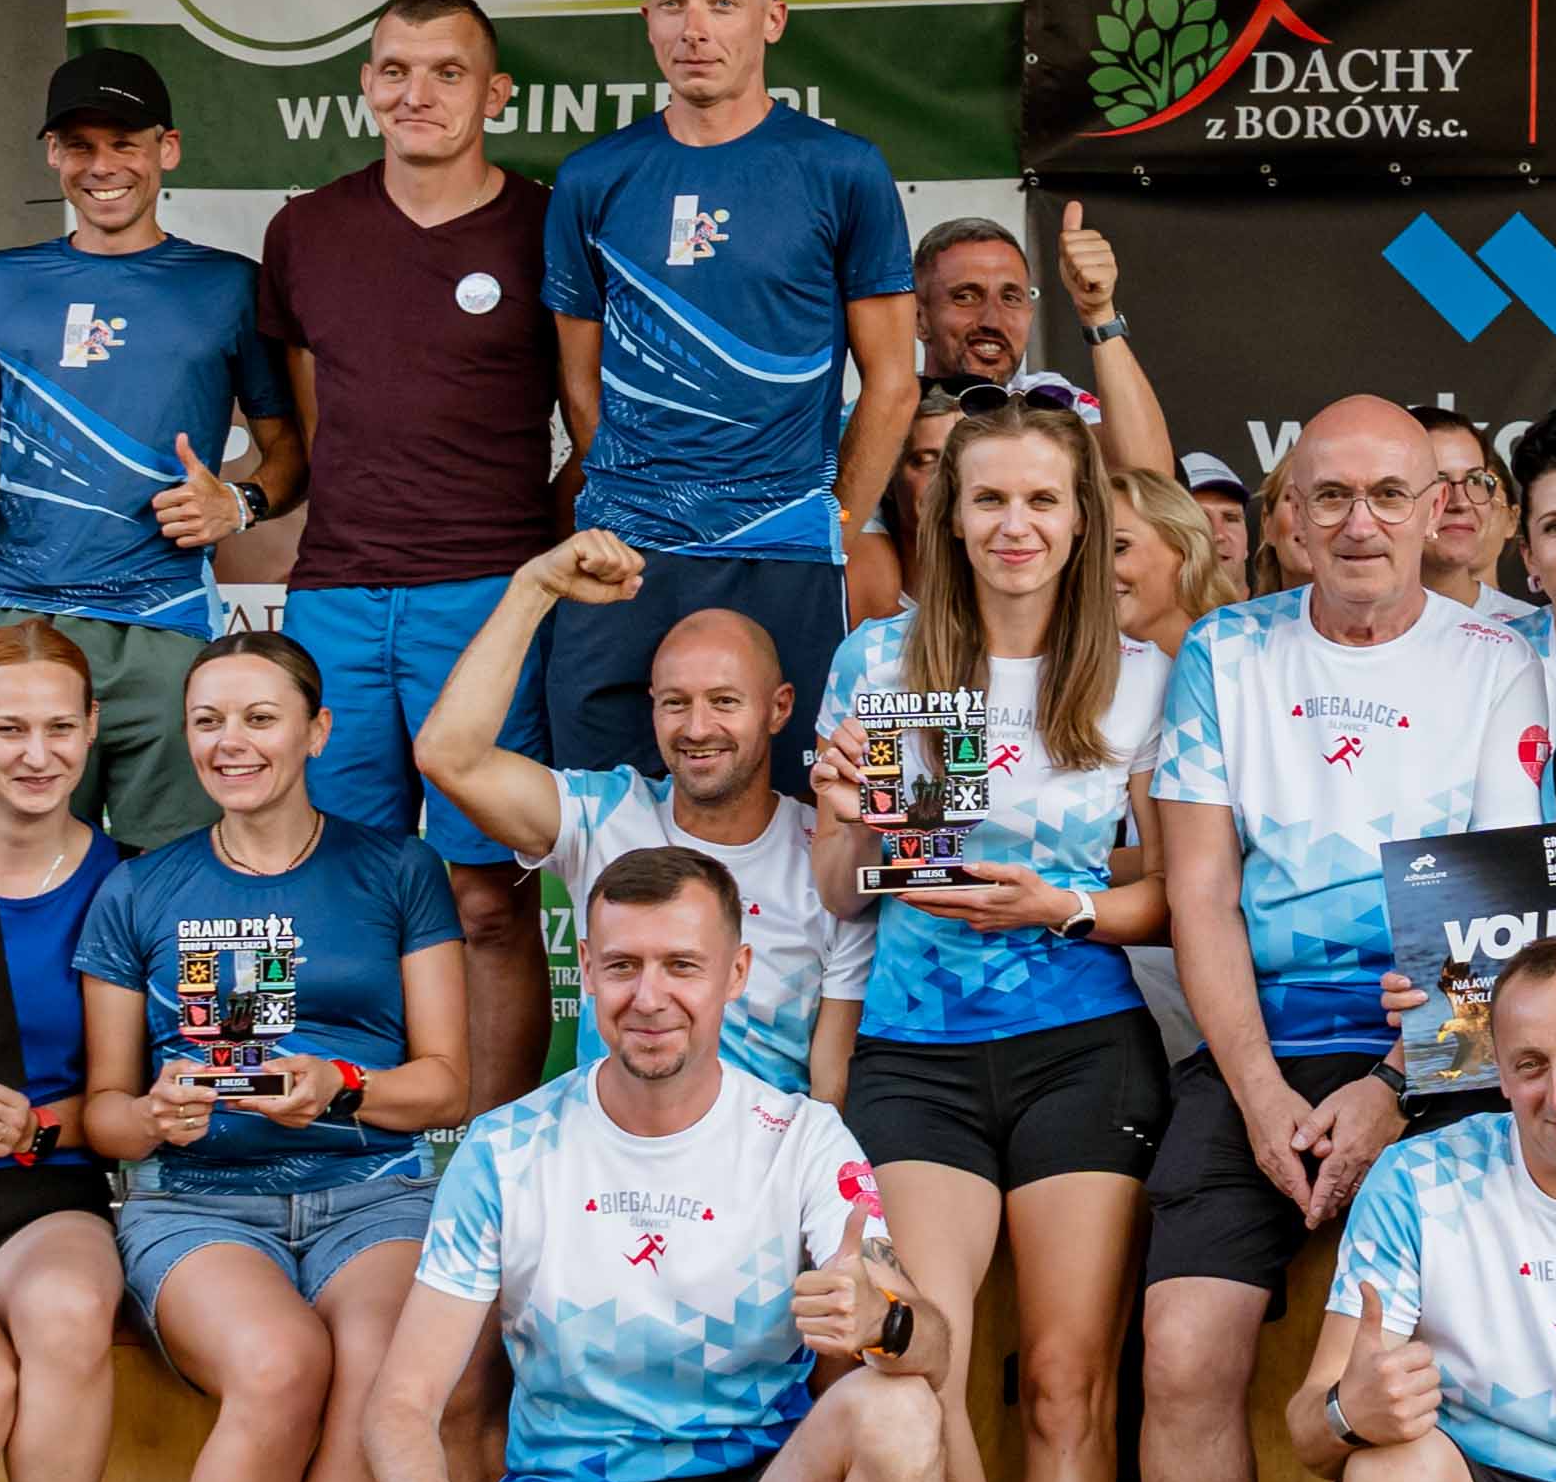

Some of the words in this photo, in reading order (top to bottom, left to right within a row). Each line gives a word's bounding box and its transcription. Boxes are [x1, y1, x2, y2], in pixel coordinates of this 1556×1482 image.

[1249, 47, 1473, 94] DACHY
[1204, 118, 1227, 140] z
[857, 693, 922, 715] GRAND
[177, 918, 237, 938] GRAND
